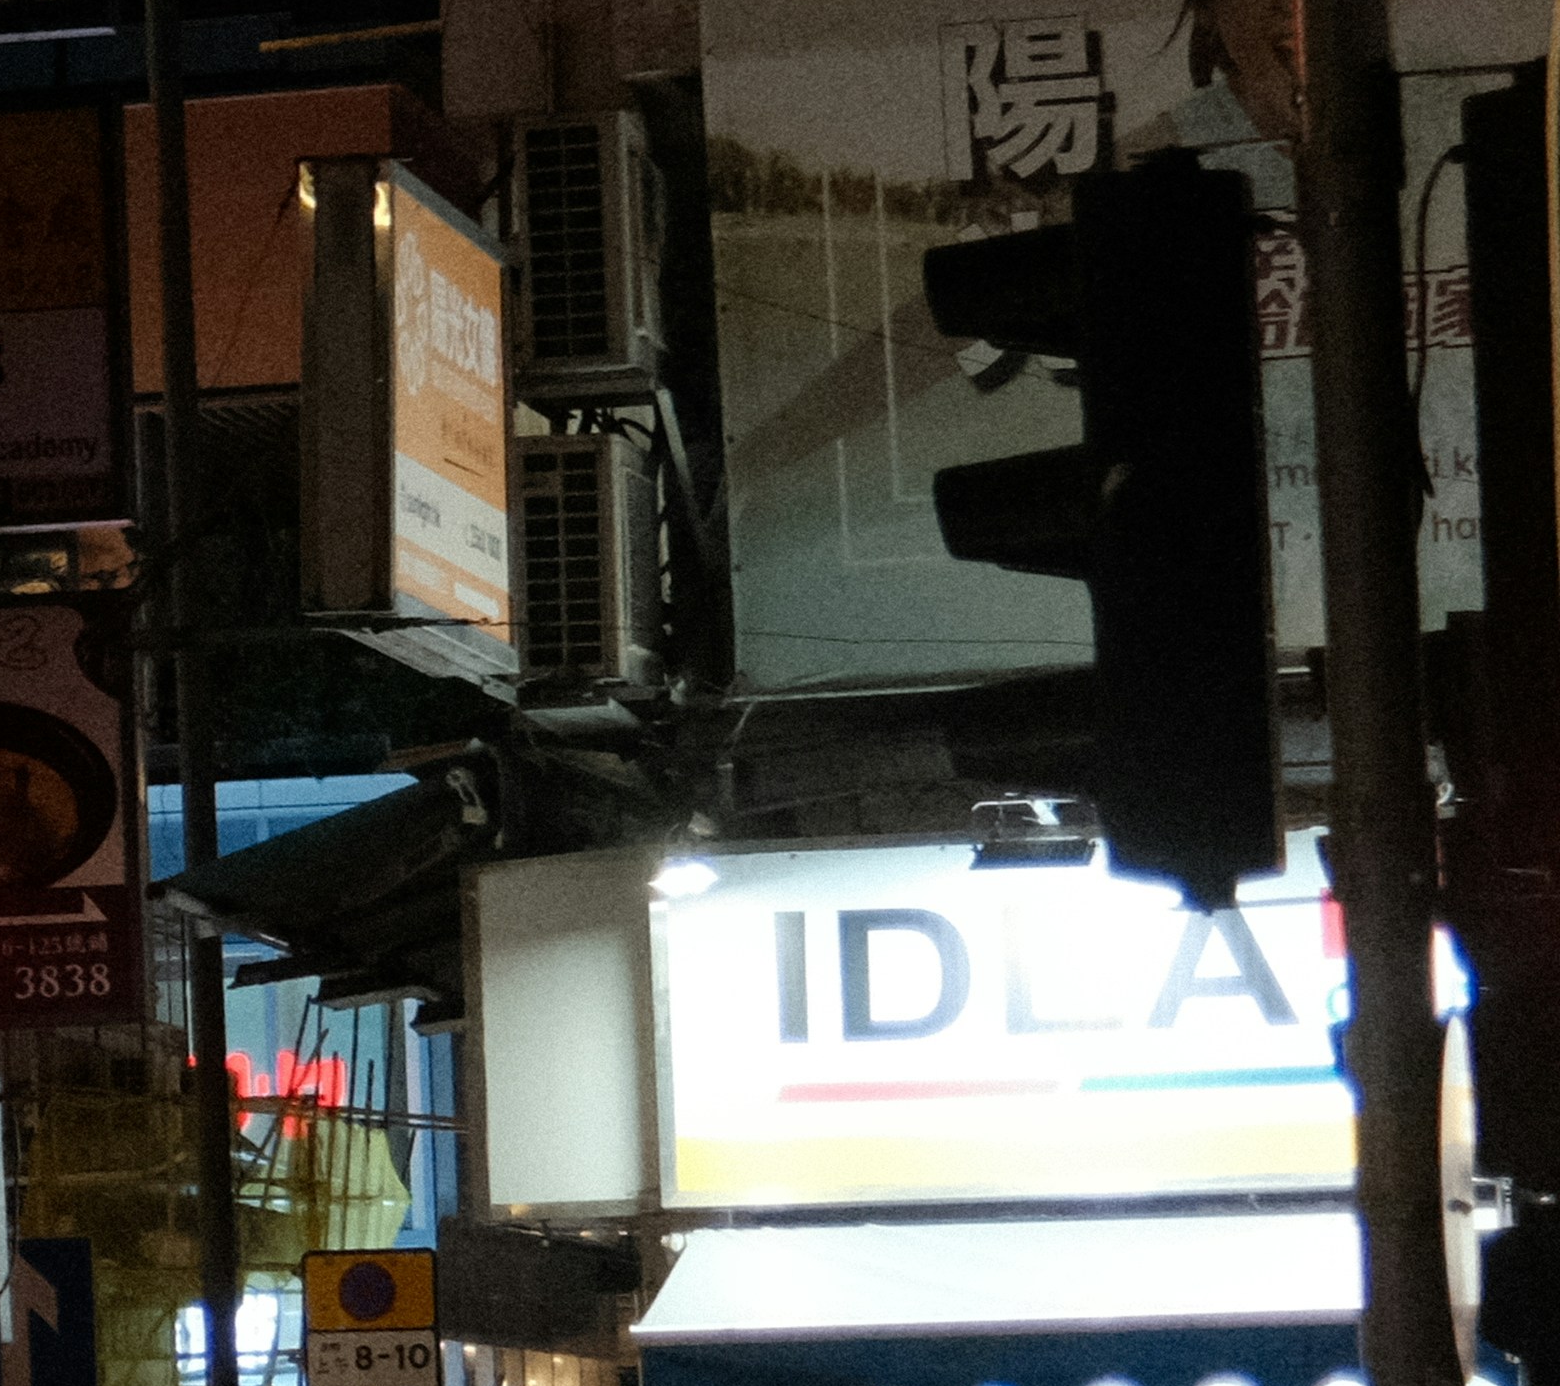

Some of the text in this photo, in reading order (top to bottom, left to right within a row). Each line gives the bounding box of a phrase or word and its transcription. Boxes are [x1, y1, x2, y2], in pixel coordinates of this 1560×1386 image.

[938, 14, 1114, 193] 陽
[13, 961, 112, 1001] 3838
[354, 1343, 431, 1371] 8-10
